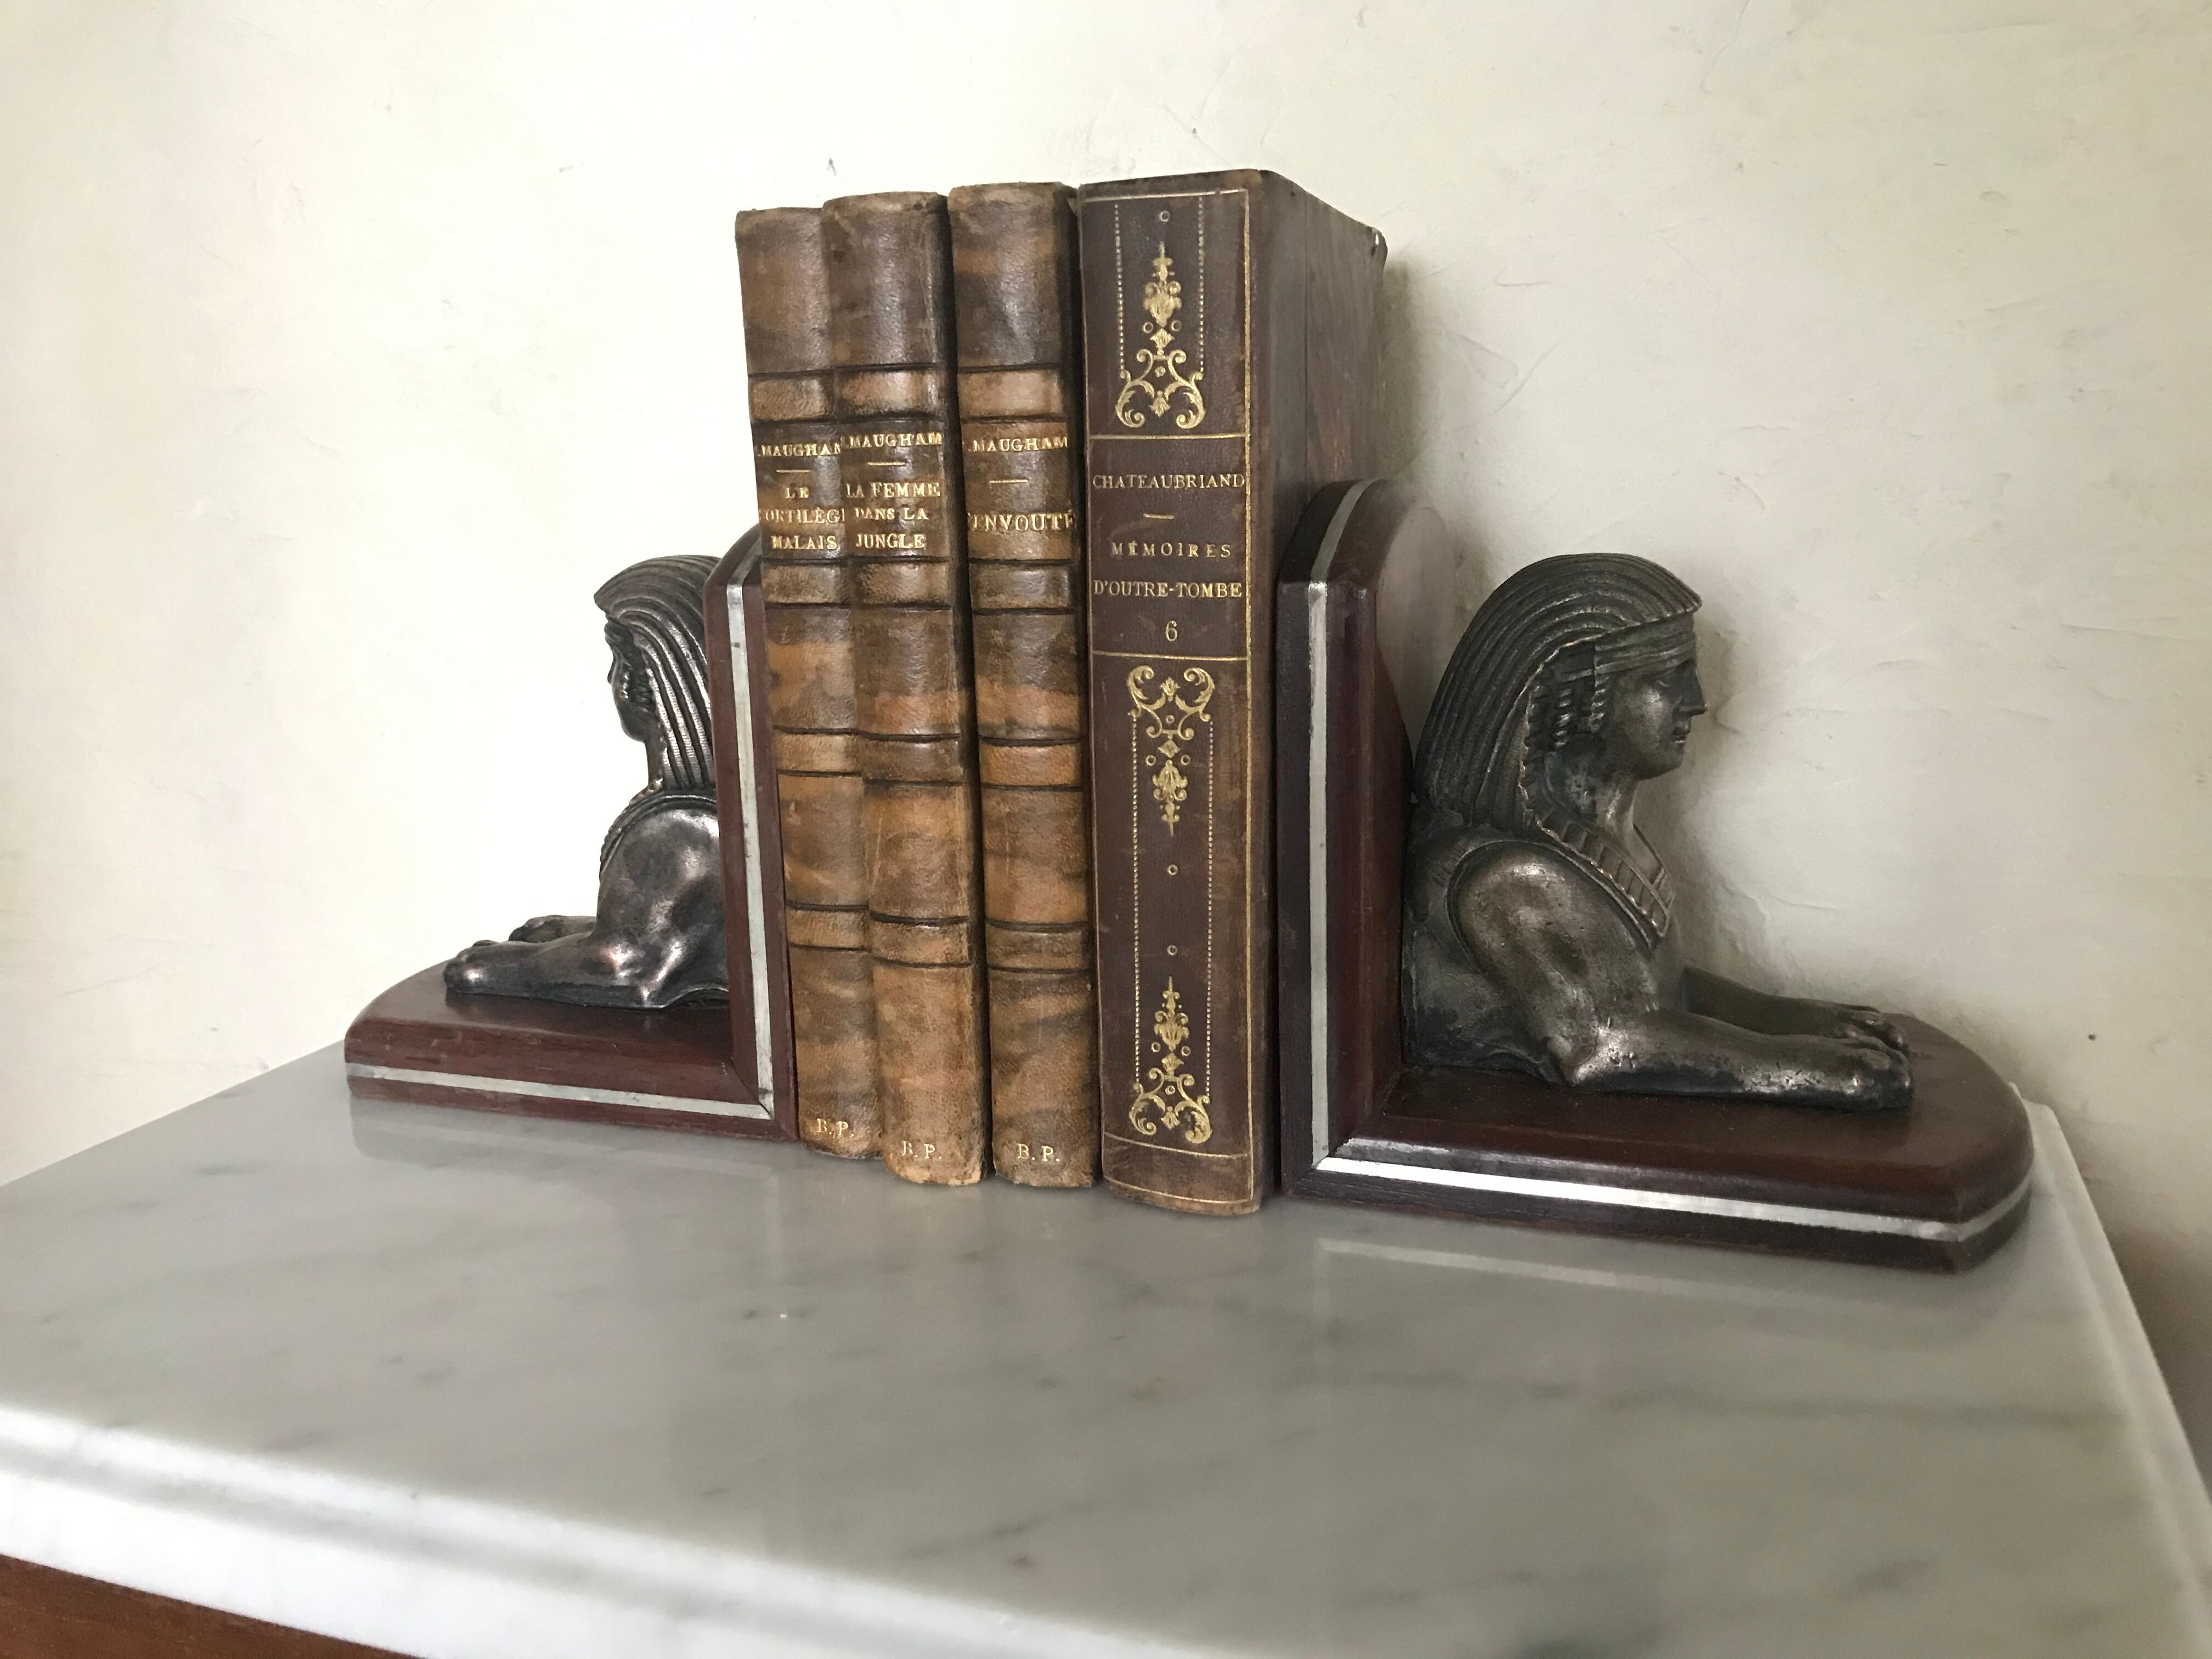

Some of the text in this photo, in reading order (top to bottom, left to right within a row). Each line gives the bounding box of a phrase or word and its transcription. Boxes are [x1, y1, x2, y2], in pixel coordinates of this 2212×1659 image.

[1092, 473, 1245, 489] CHATEAUBRIAND
[785, 487, 810, 499] LE
[846, 482, 941, 498] LA FEMME
[854, 507, 929, 520] DANS LA
[771, 535, 838, 550] MALAIS
[855, 533, 926, 549] JUNGLE
[1111, 540, 1232, 558] MÉMOIRES
[1093, 579, 1243, 598] D'OUTRE-TOMBE
[1165, 620, 1178, 642] 6
